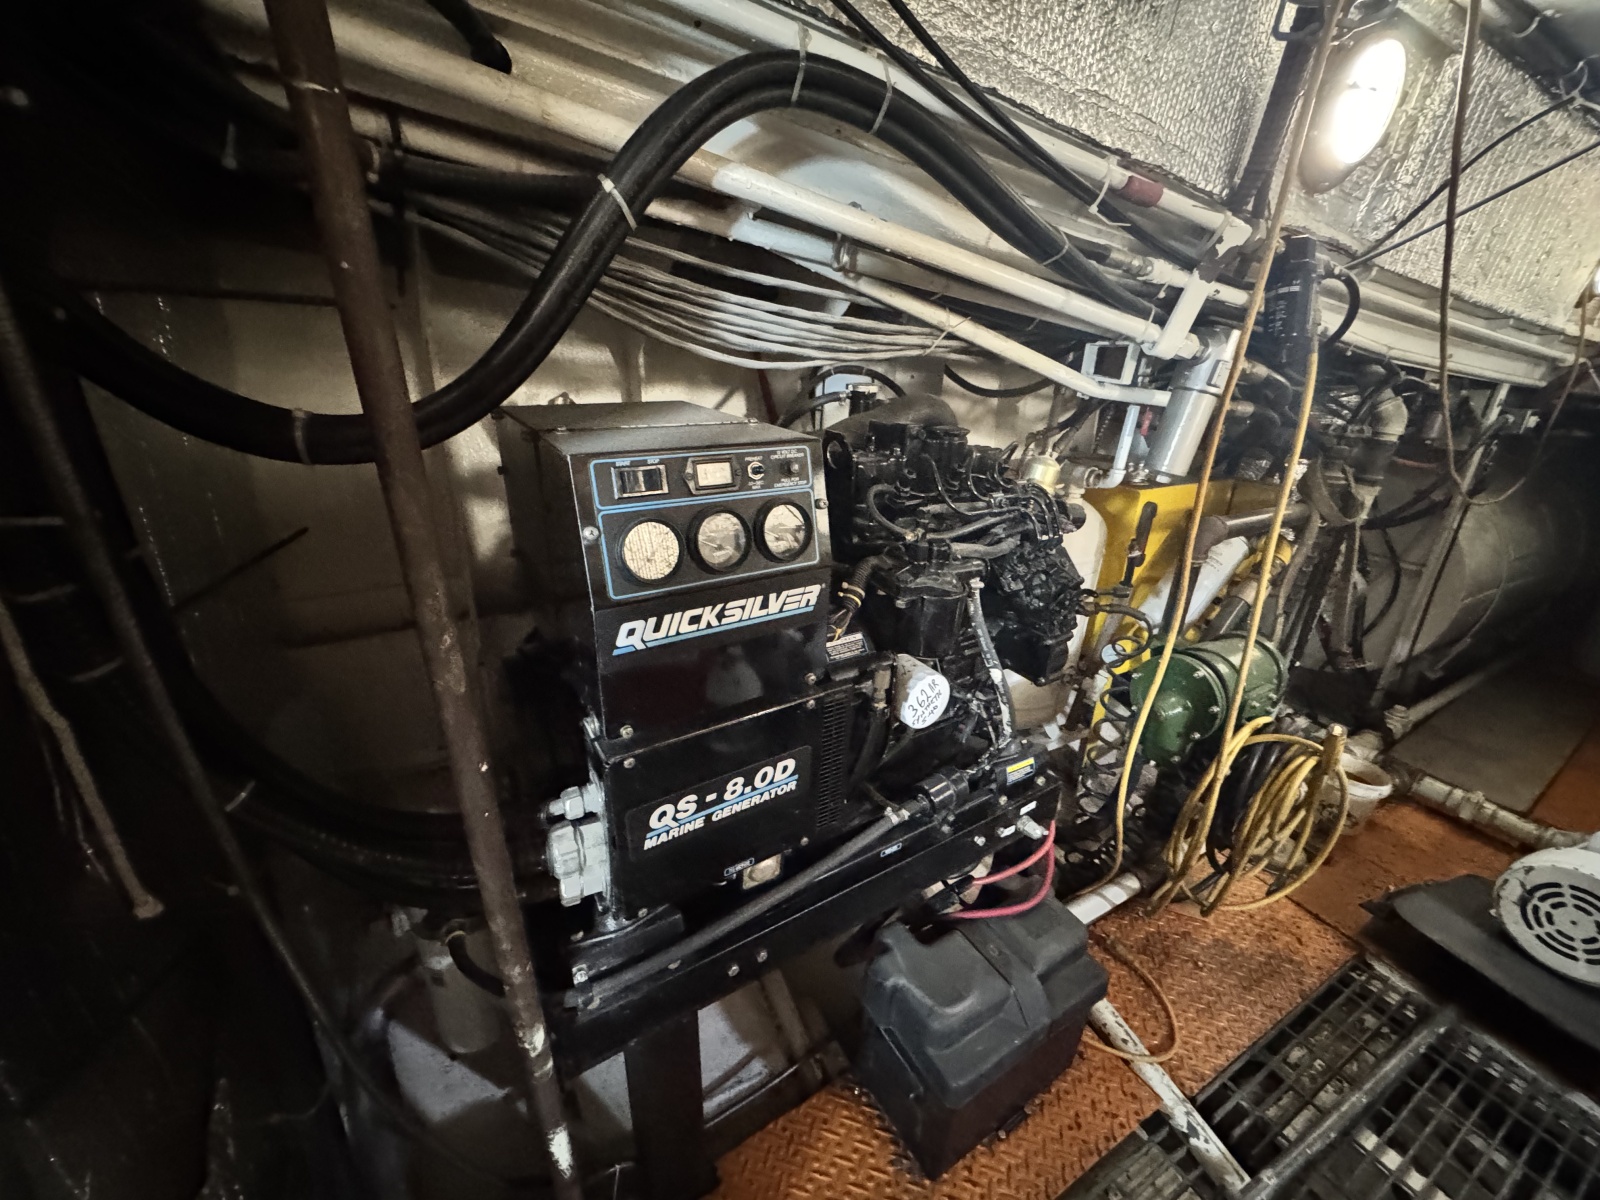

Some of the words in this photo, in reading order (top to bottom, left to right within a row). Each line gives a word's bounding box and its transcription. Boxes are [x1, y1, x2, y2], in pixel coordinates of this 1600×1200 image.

[615, 584, 821, 650] QUICKSILVER
[908, 689, 932, 718] 362
[644, 817, 705, 850] MARINE
[711, 780, 798, 822] GENERATOR
